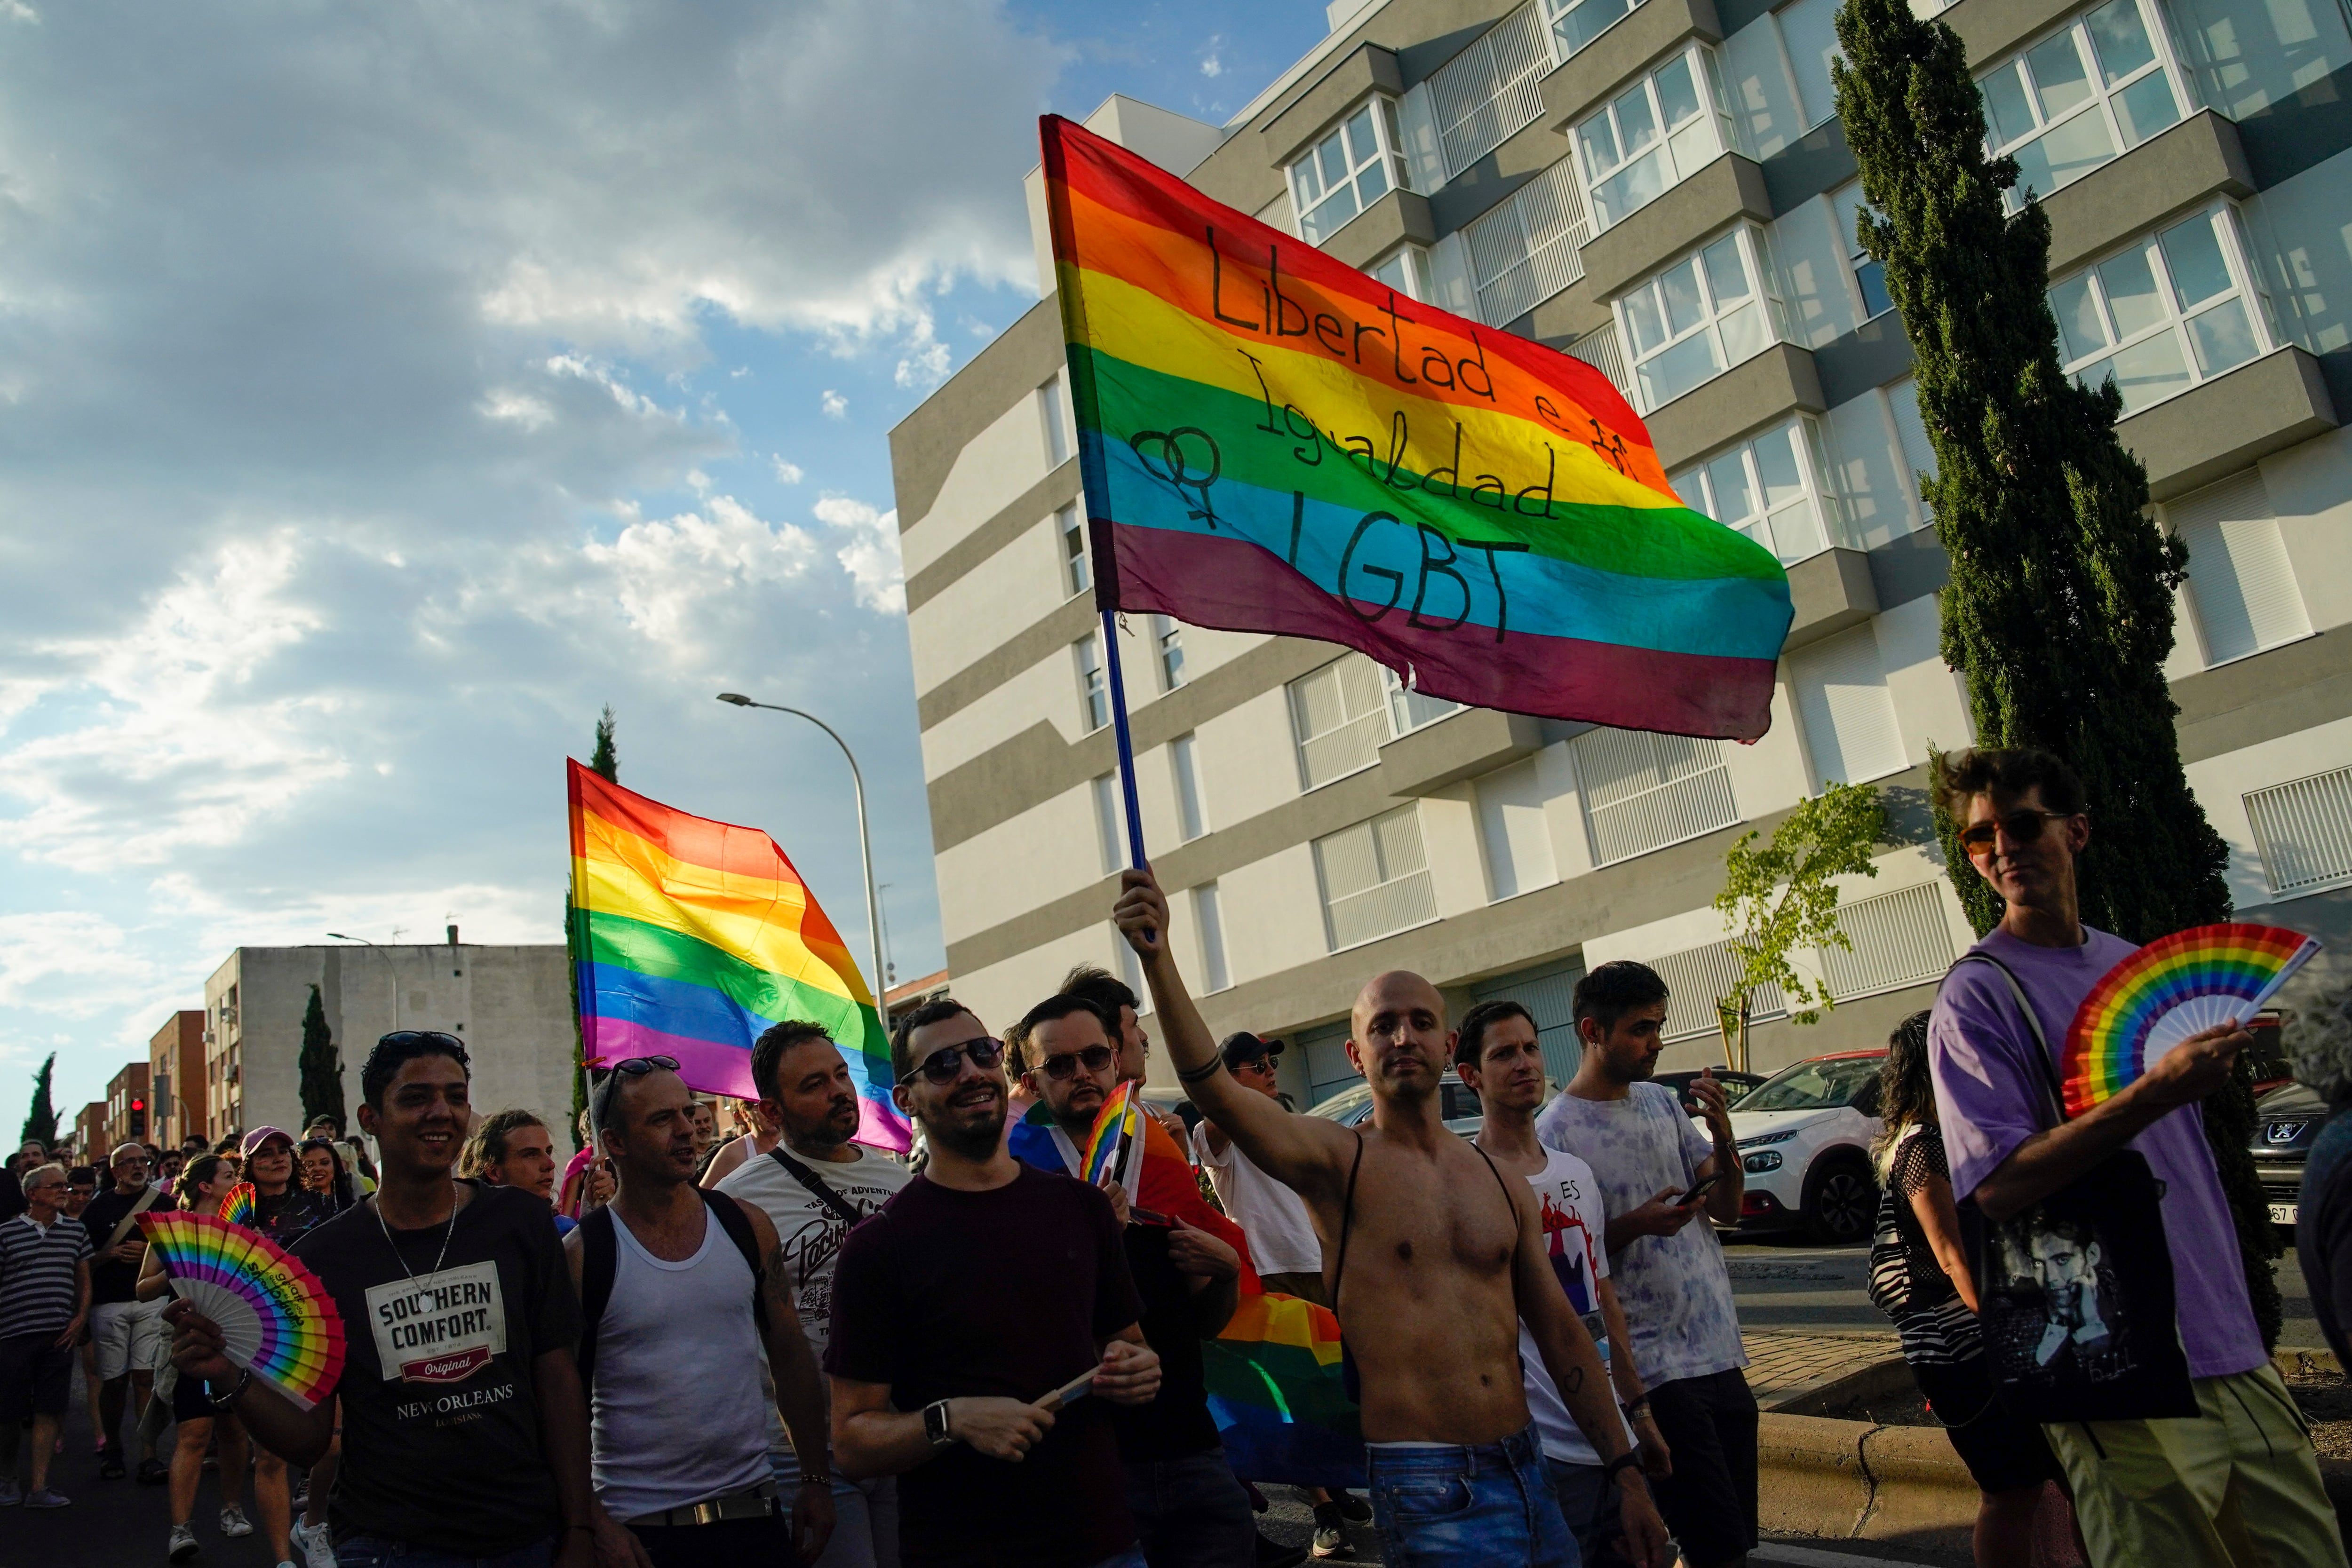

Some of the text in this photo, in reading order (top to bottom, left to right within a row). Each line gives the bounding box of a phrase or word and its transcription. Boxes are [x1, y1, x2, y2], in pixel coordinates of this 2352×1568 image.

[1206, 225, 1570, 432] Libertad e
[1237, 348, 1559, 520] Igualdad
[804, 1198, 824, 1210] TAS
[851, 1186, 897, 1196] ADVENTU
[1560, 1179, 1581, 1200] ES
[2272, 1207, 2286, 1220] 67
[378, 1282, 491, 1326] SOUTHERN
[425, 1356, 471, 1375] Original
[397, 1384, 513, 1420] NEW ORLEANS
